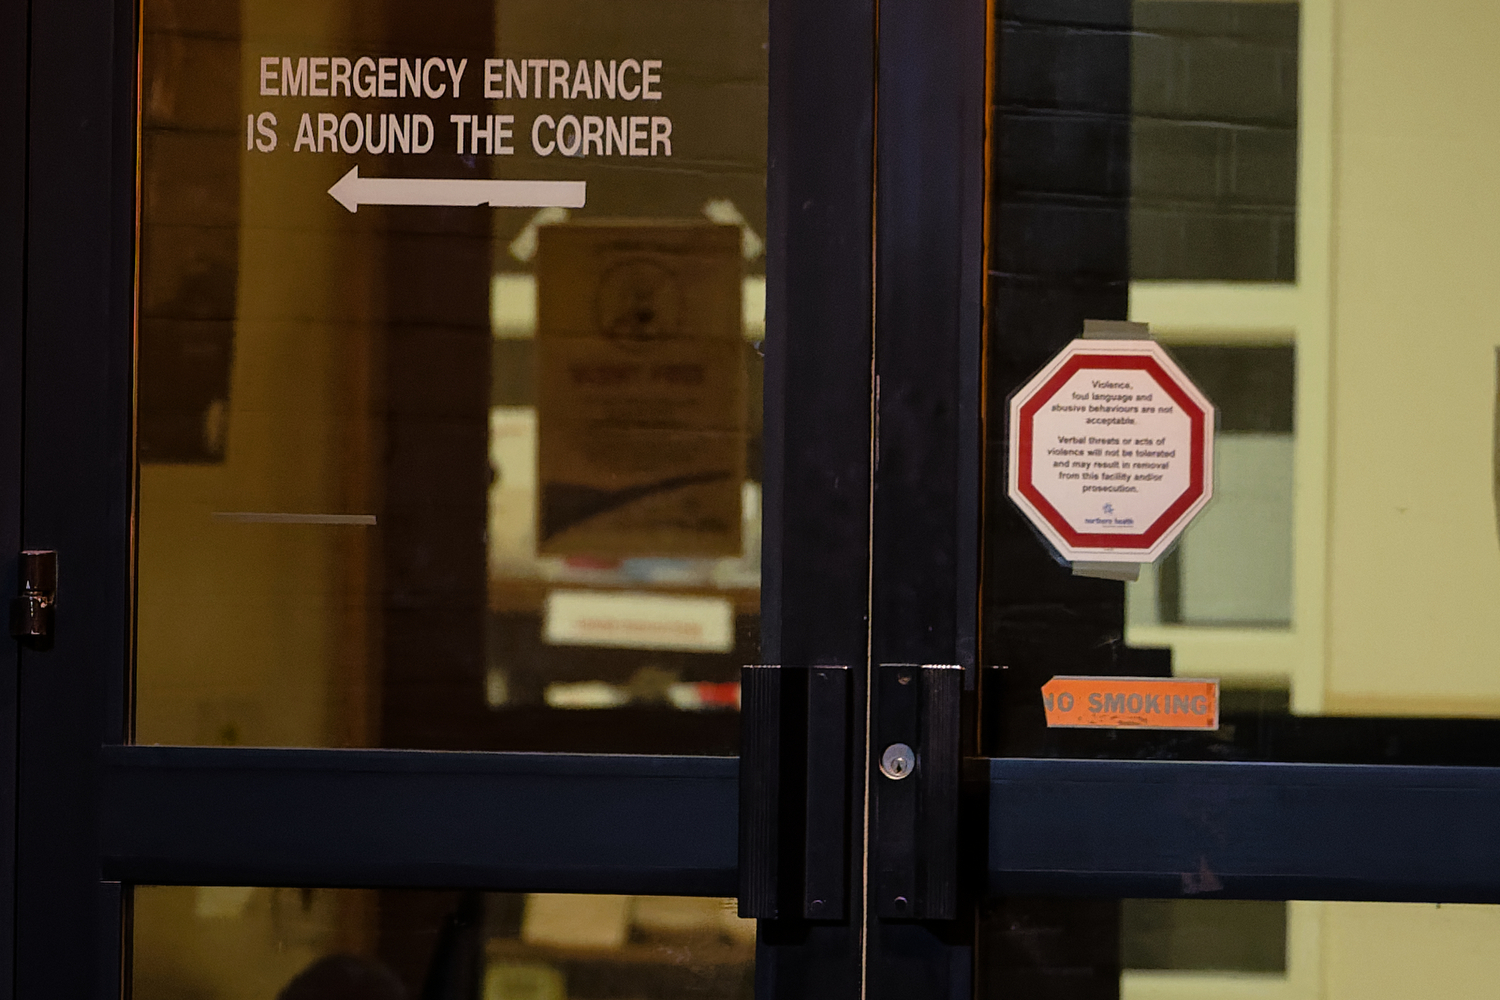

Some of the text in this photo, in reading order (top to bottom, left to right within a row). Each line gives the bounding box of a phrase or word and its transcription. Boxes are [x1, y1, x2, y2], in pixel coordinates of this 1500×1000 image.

[260, 57, 662, 100] EMERGENCY ENTRANCE
[247, 112, 672, 156] IS AROUND THE CORNER
[1091, 380, 1133, 390] Violence,
[1072, 391, 1153, 403] foul language and
[1051, 403, 1086, 412] abusive
[1088, 404, 1139, 413] behaviours
[1158, 406, 1173, 414] not
[1057, 436, 1086, 444] Verbal
[1088, 437, 1120, 445] threats
[1134, 438, 1153, 446] acts
[1155, 437, 1166, 446] of
[1047, 447, 1176, 458] violence will not be tolerated
[1053, 460, 1070, 468] and
[1072, 461, 1091, 470] may
[1093, 461, 1120, 469] result
[1132, 462, 1169, 470] removal
[1058, 471, 1163, 483] from this facility and/or
[1082, 484, 1138, 493] prosecution.
[1088, 692, 1207, 715] SMOKING
